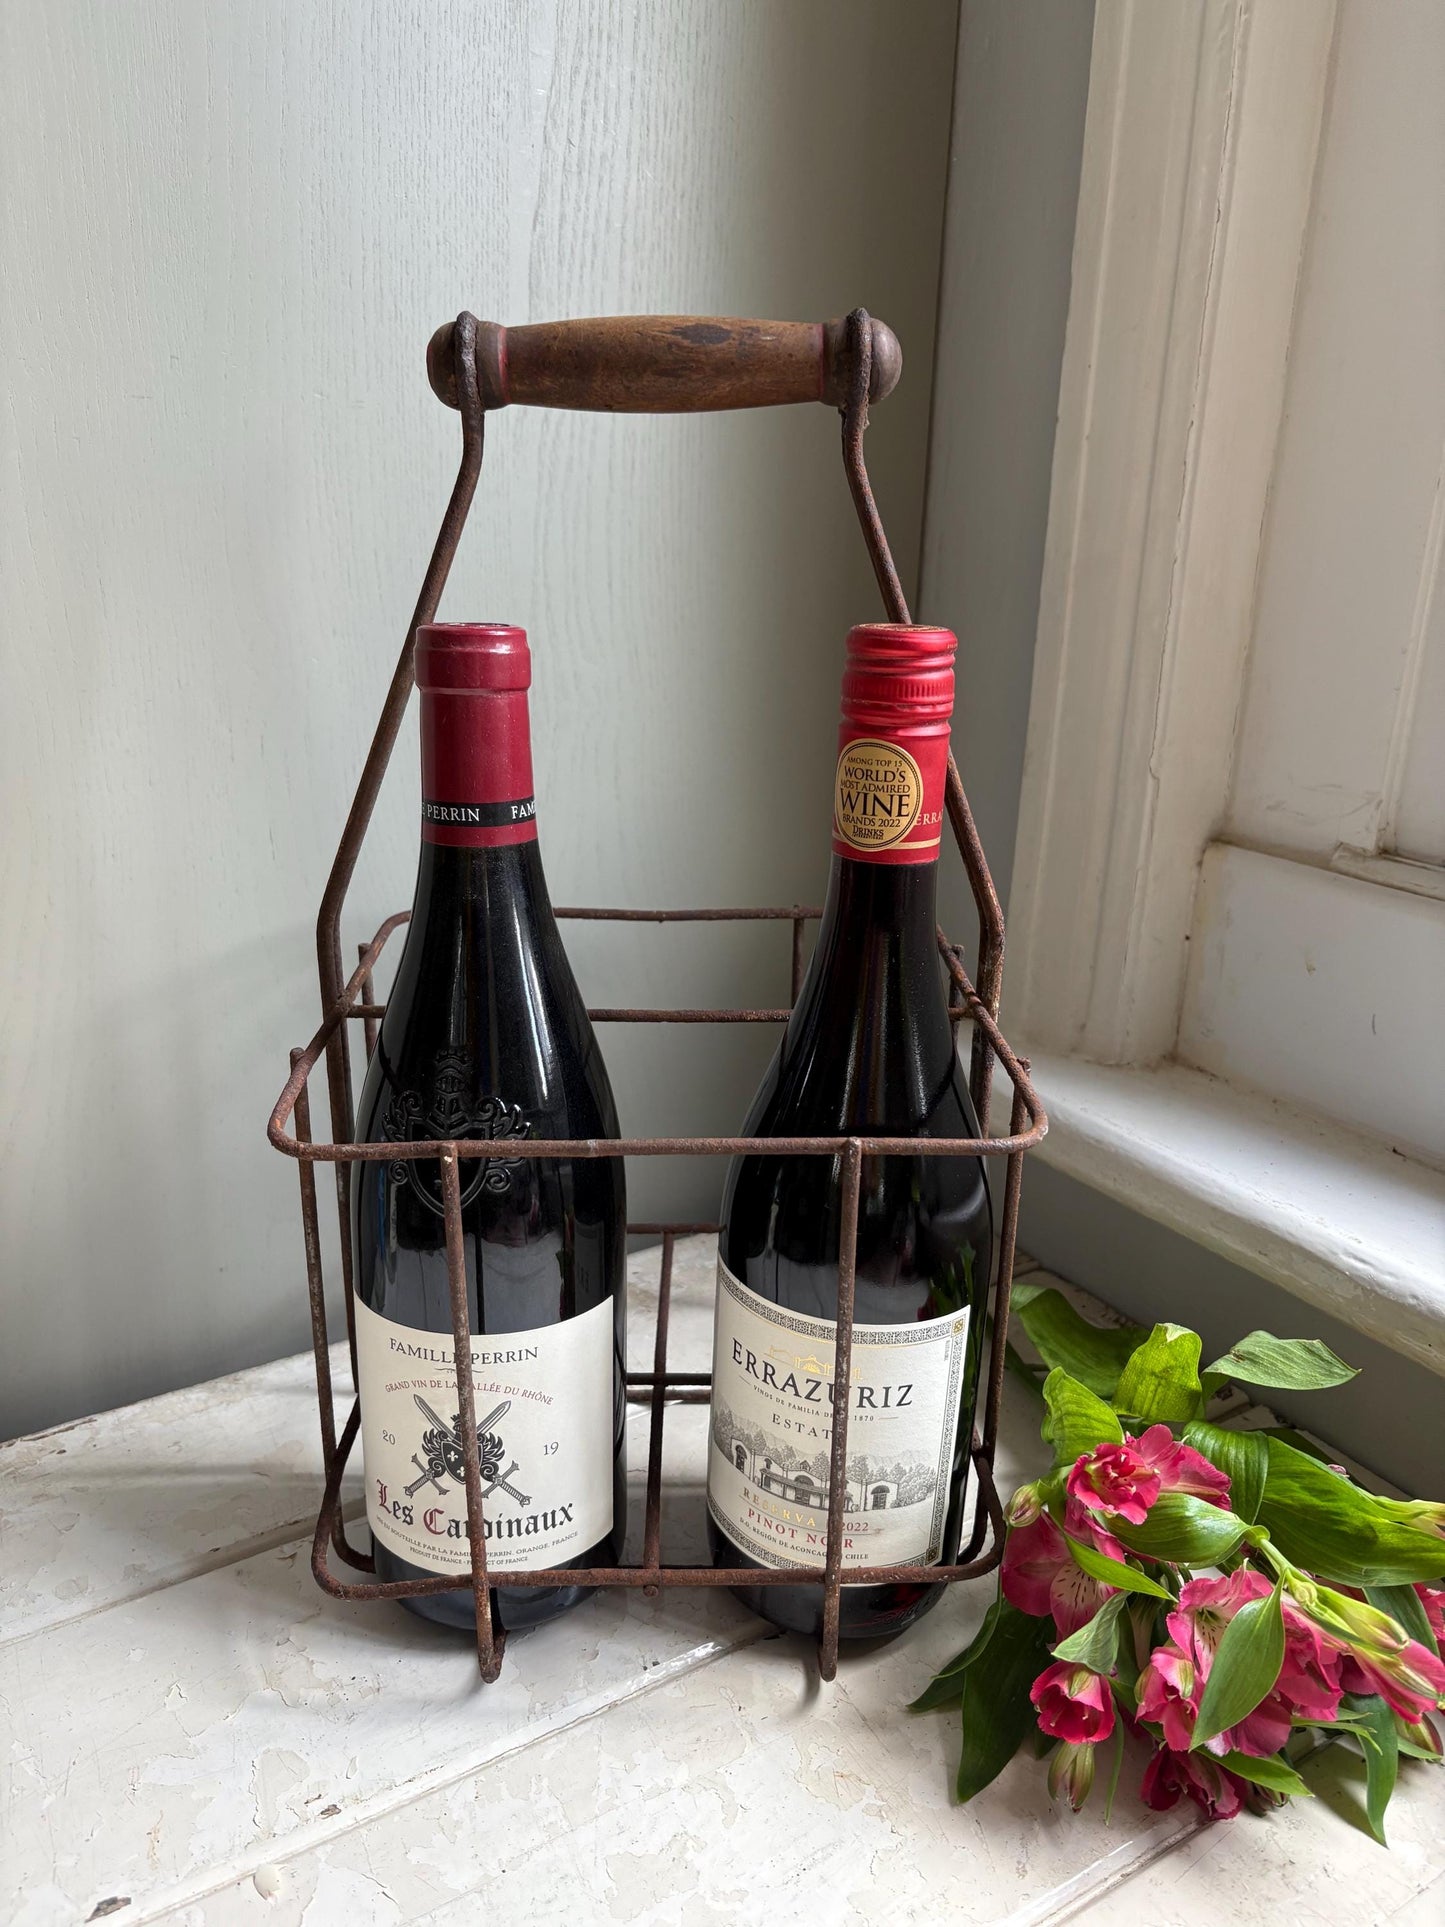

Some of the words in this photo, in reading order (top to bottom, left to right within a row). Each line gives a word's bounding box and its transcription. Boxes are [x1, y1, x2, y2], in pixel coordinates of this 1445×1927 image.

[847, 756, 873, 766] AMONG
[876, 759, 892, 767] TOP
[841, 778, 861, 790] MOST
[861, 781, 911, 793] ADMIRED
[844, 765, 906, 783] WORLD'S
[427, 804, 480, 822] PERRIN
[840, 788, 910, 818] WINE
[842, 813, 876, 827] BRANDS
[878, 818, 901, 828] 2022
[853, 825, 884, 837] DRINKS
[390, 1337, 457, 1364] FAMILL
[471, 1346, 539, 1365] PERRIN
[385, 1380, 410, 1393] GRAND
[411, 1380, 428, 1389] VIN
[429, 1380, 443, 1389] DE
[445, 1380, 458, 1389] LA
[503, 1385, 520, 1396] DU
[521, 1389, 554, 1406] RHÔNE
[753, 1384, 774, 1400] VINOS
[775, 1396, 786, 1406] DE
[787, 1402, 821, 1417] FAMILIA
[772, 1413, 834, 1440] ESTAT
[382, 1429, 396, 1445] 20
[543, 1441, 559, 1456] 19
[376, 1478, 414, 1526] Les
[743, 1487, 817, 1527] RESERVA
[748, 1508, 799, 1539] PINOT
[806, 1532, 854, 1549] NOR
[422, 1543, 437, 1553] PAR
[552, 1530, 579, 1547] FRANCE
[778, 1541, 790, 1549] DE
[440, 1556, 462, 1565] FRANCE
[505, 1556, 529, 1565] FRANCE
